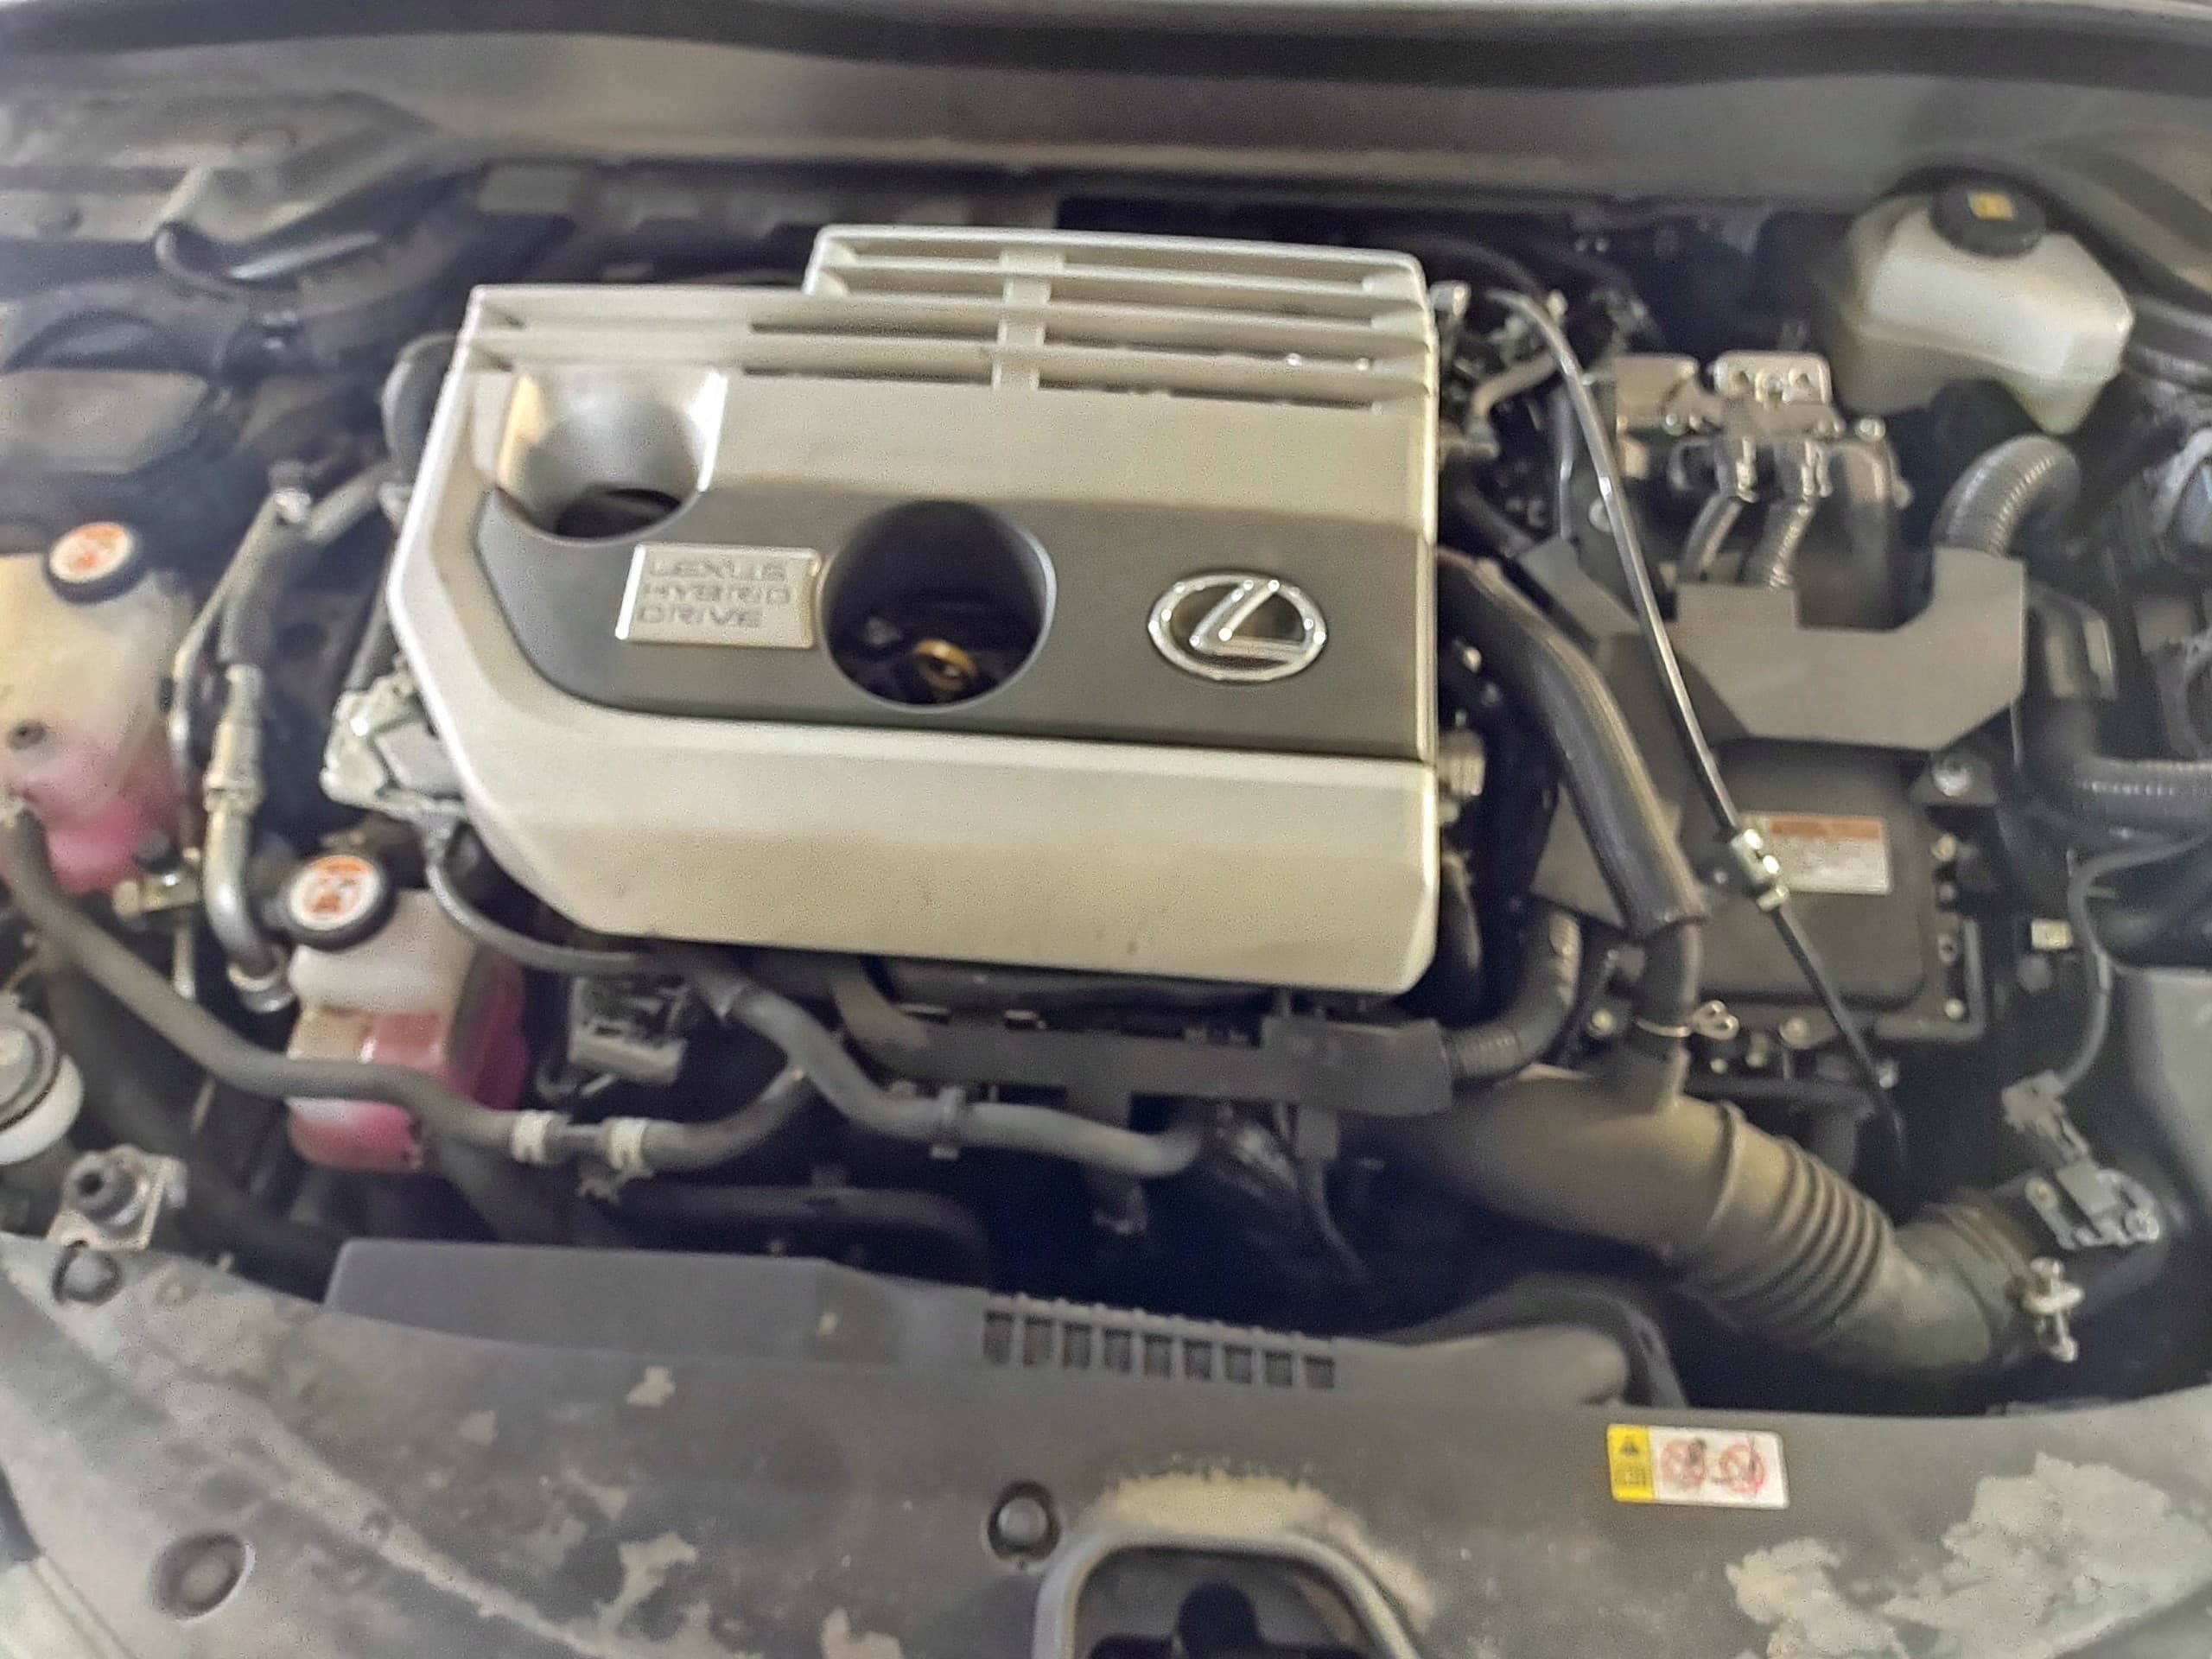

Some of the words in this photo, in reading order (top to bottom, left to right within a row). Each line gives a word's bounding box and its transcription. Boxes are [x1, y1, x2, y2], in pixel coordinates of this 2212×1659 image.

[649, 560, 786, 582] LEXUS
[643, 582, 791, 606] HYBRID
[637, 604, 763, 628] DRIVE
